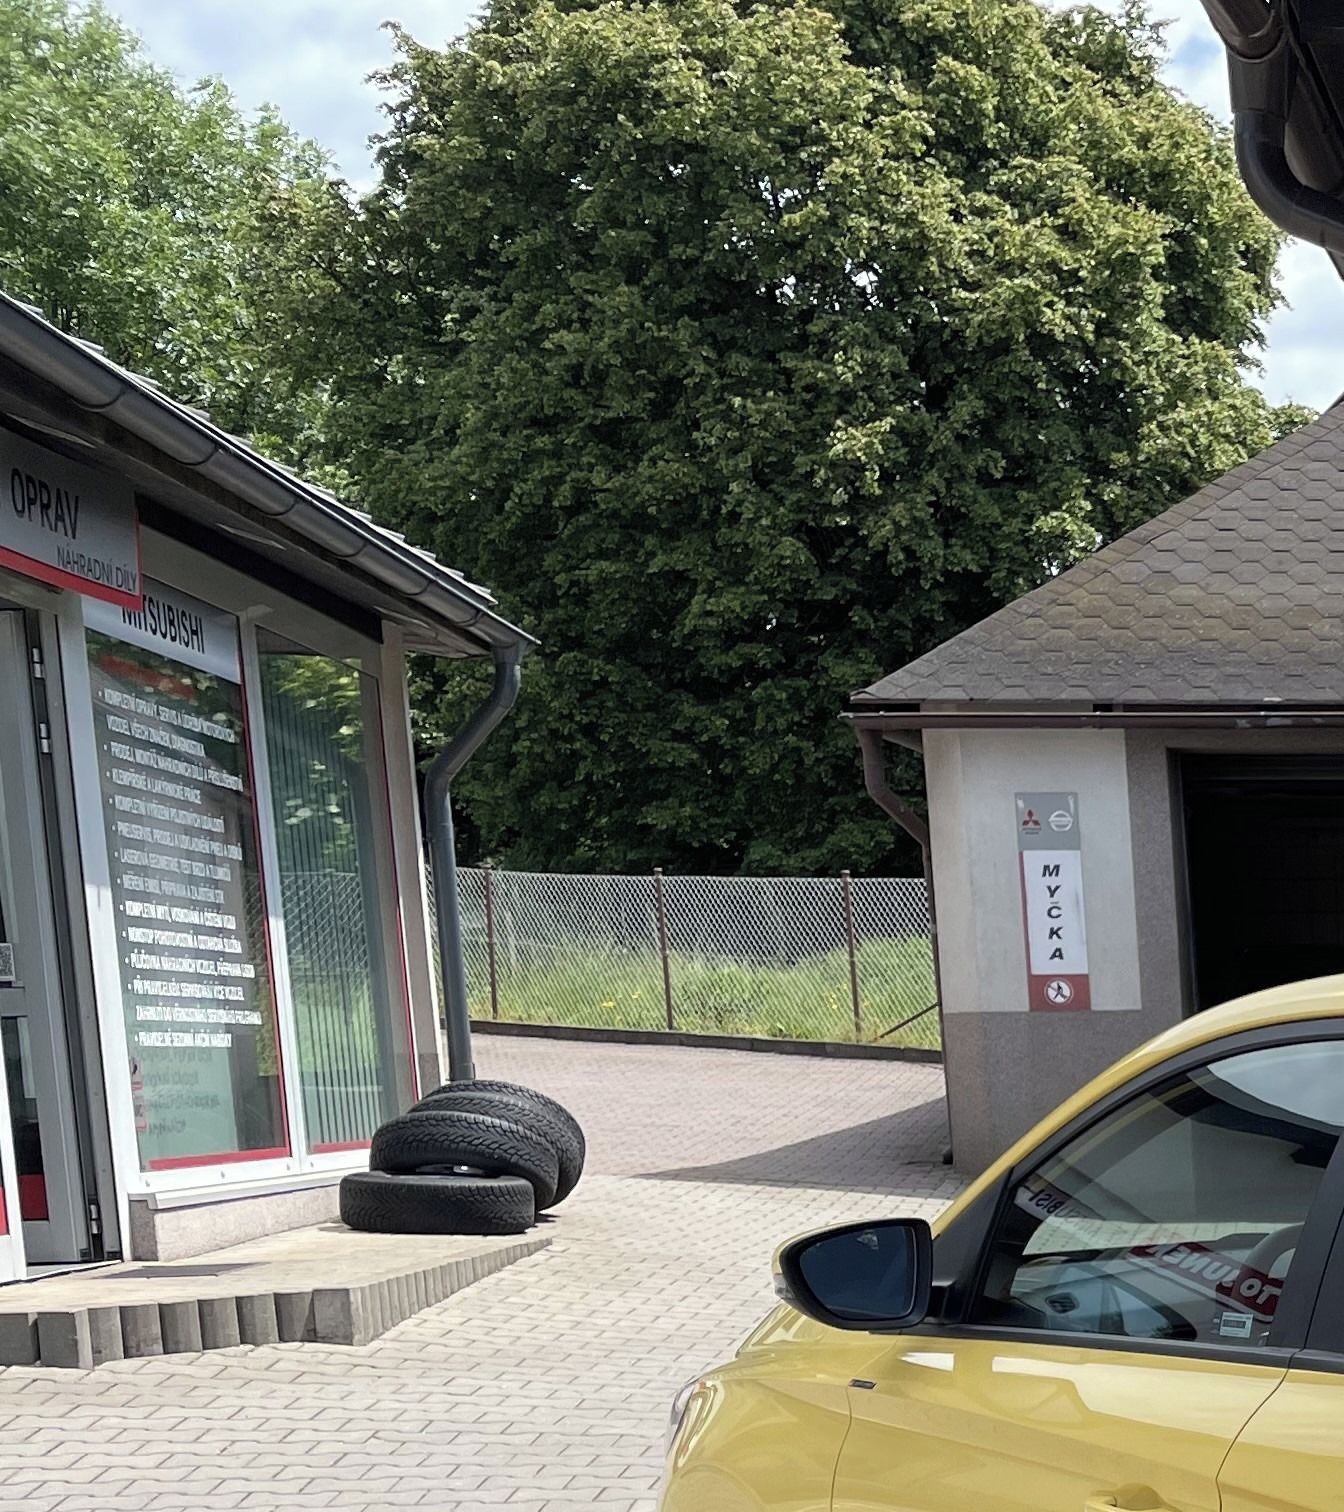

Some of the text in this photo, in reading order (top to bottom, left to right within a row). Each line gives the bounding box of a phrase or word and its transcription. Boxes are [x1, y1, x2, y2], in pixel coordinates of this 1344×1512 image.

[10, 468, 79, 540] OPRAV
[56, 543, 138, 593] NÁHRADNÍ DÍLY
[1042, 862, 1065, 961] MYČKA
